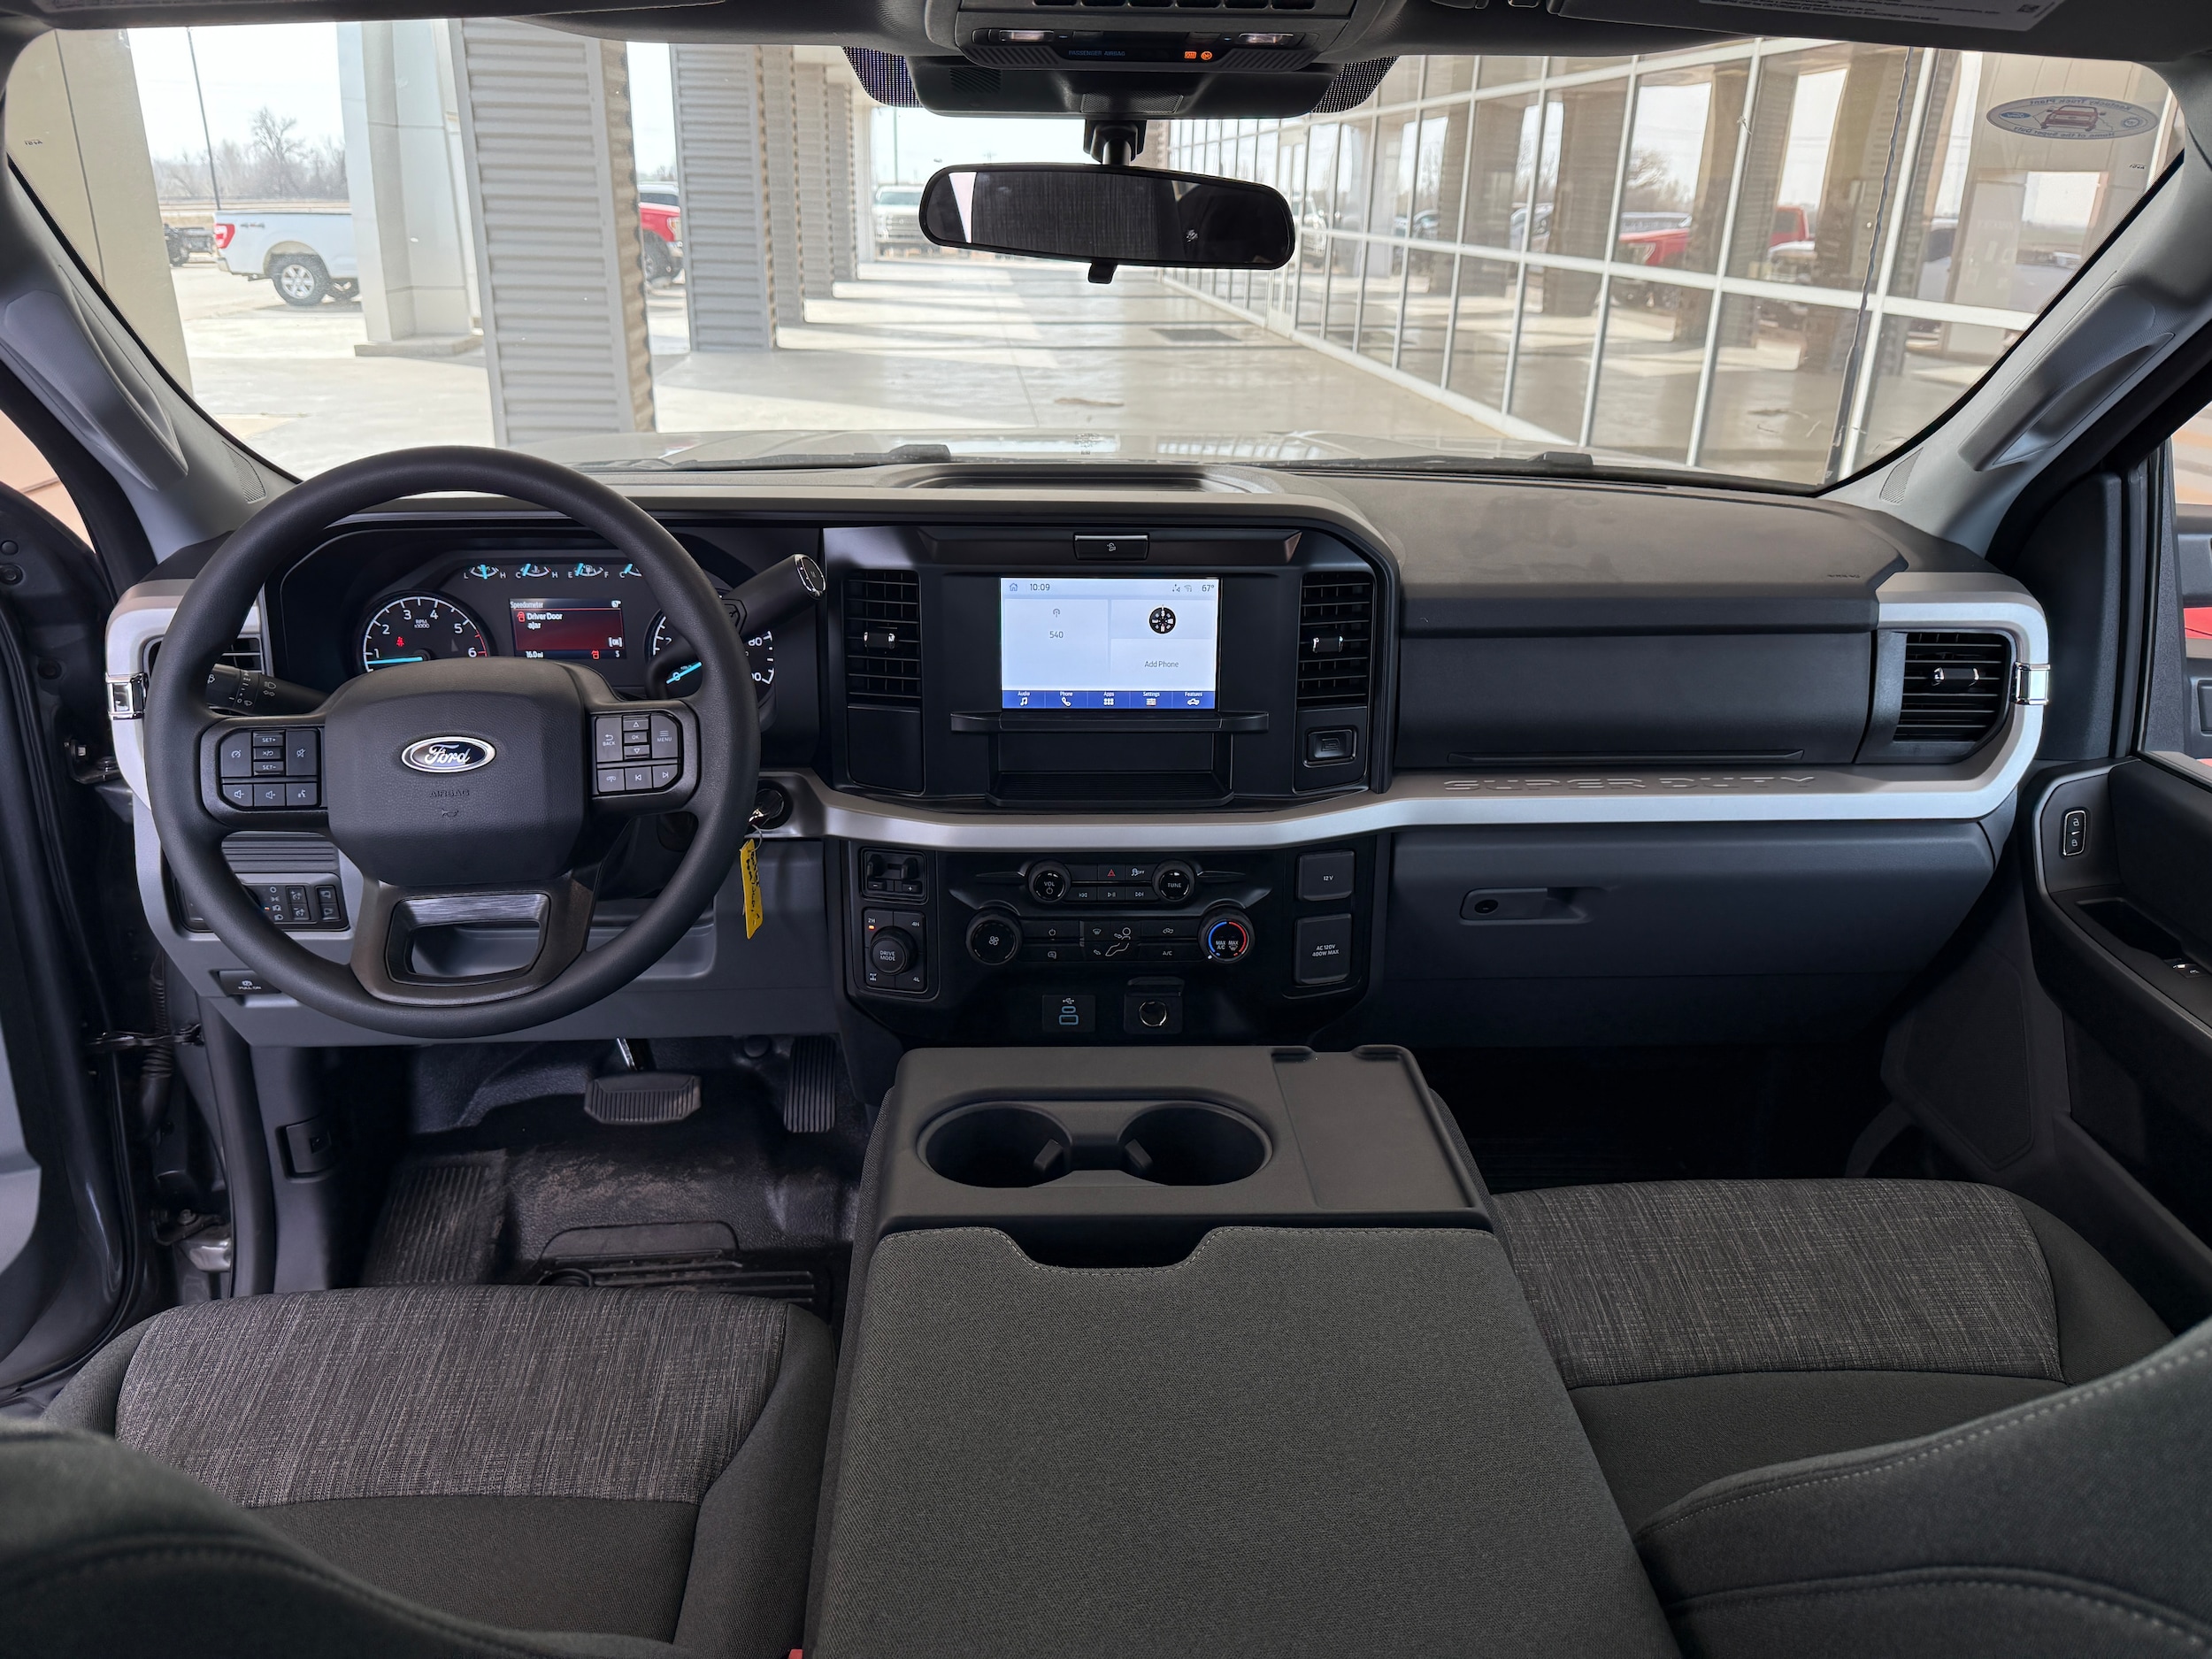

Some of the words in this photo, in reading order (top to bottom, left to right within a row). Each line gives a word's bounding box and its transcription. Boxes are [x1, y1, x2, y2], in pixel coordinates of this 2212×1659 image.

[510, 601, 544, 610] Speedometer
[403, 610, 412, 621] 3
[429, 610, 439, 621] 4
[381, 625, 391, 635] 2
[453, 623, 464, 634] 5
[527, 621, 541, 630] ajar
[373, 648, 380, 658] 1
[468, 647, 478, 658] 6
[424, 744, 471, 764] Ford
[1443, 777, 1646, 792] SUPER
[1658, 775, 1816, 790] DUTY
[429, 789, 470, 798] AIRBAG
